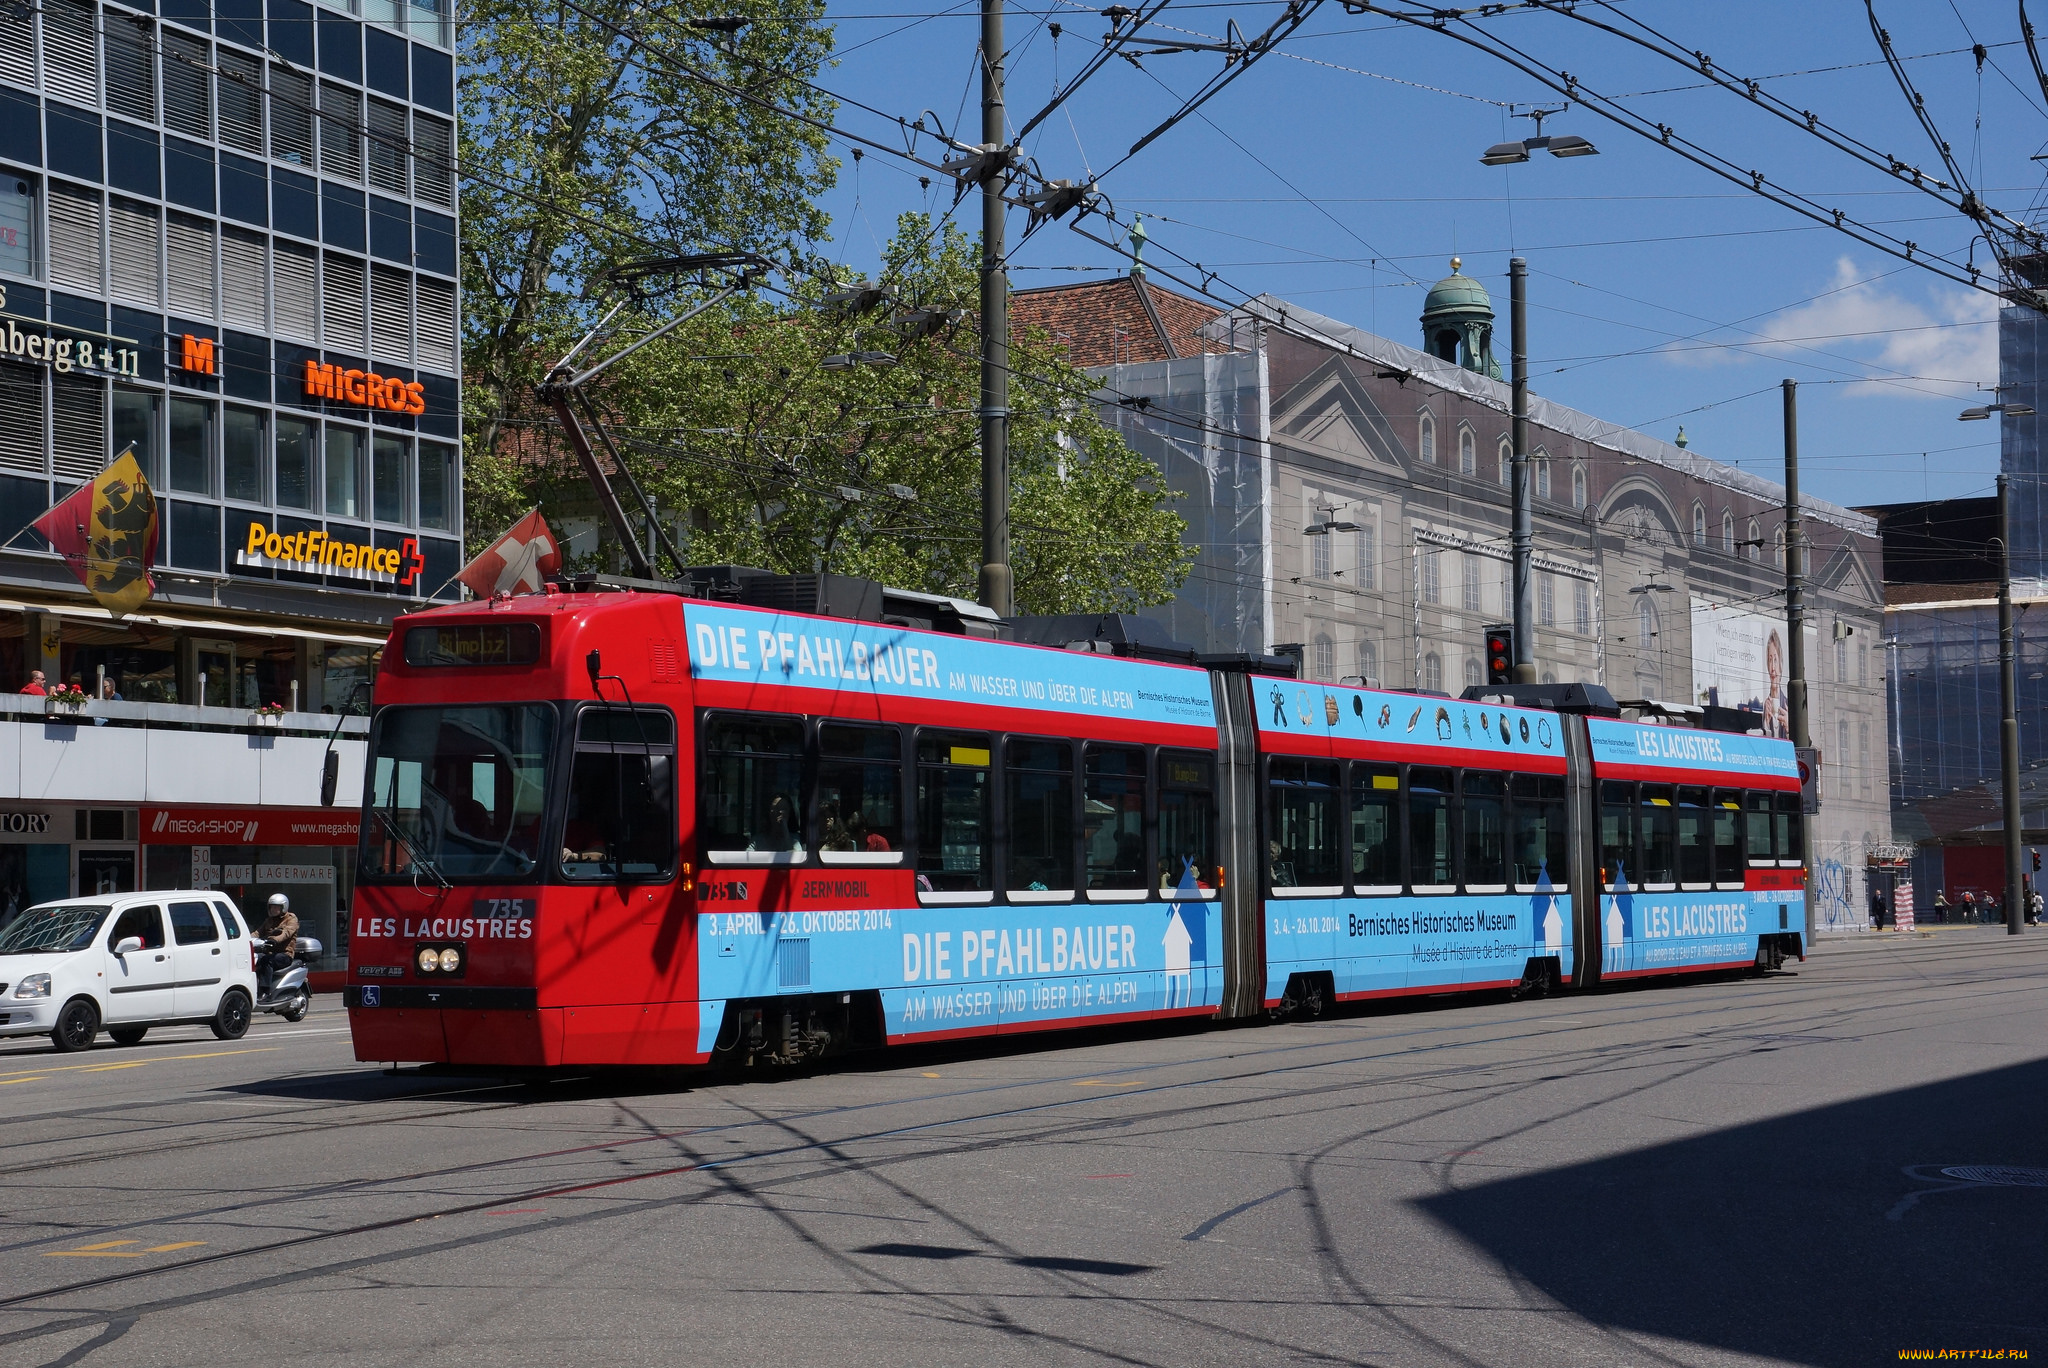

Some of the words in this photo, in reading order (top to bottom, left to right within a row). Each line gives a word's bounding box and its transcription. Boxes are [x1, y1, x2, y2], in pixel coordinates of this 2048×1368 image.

[182, 333, 214, 375] M
[305, 360, 426, 415] MIGROS
[247, 522, 400, 574] PostFinance
[695, 623, 751, 670] DIE
[758, 630, 941, 688] PFAHLBAUER
[949, 671, 966, 691] AM
[969, 674, 1018, 697] WASSER
[1021, 680, 1045, 700] UND
[1048, 678, 1078, 704] ÜBER
[1080, 686, 1099, 706] DIE
[1101, 690, 1134, 710] ALPEN
[1137, 690, 1164, 702] Bernisches
[1164, 693, 1191, 706] Historisches
[1191, 696, 1210, 707] Museum
[1636, 729, 1659, 758] LES
[1659, 732, 1724, 763] LACUSTRES
[168, 819, 245, 834] MEGA-SHOP
[193, 849, 209, 863] 50
[226, 867, 250, 879] AUF
[488, 898, 523, 919] 735
[1644, 906, 1670, 938] LES
[1674, 903, 1747, 937] LACUSTRES
[356, 918, 397, 937] LES
[403, 918, 532, 939] LACUSTRES
[709, 914, 722, 937] 3.
[726, 913, 767, 936] APRIL
[780, 912, 799, 934] 26.
[803, 910, 861, 933] OKTOBER
[864, 909, 892, 931] 2014
[1349, 913, 1410, 937] Bernisches
[1412, 911, 1475, 935] Historisches
[1477, 910, 1517, 932] Museum
[903, 931, 951, 982] DIE
[963, 925, 1137, 978] PFAHLBAUER
[1413, 942, 1441, 963] Musée
[1442, 941, 1481, 962] d'Histoire
[1483, 941, 1493, 959] de
[1494, 940, 1517, 959] Berne
[1653, 948, 1668, 962] BORD
[1668, 947, 1676, 961] DE
[1690, 946, 1697, 959] ET
[1701, 944, 1723, 958] TRAVERS
[1723, 943, 1732, 956] LES
[1733, 942, 1747, 956] ALPES
[902, 996, 926, 1023] AM
[933, 992, 992, 1018] WASSER
[999, 987, 1026, 1014] UND
[1032, 982, 1067, 1011] ÜBER
[1072, 985, 1093, 1007] DIE
[1098, 981, 1138, 1004] ALPEN
